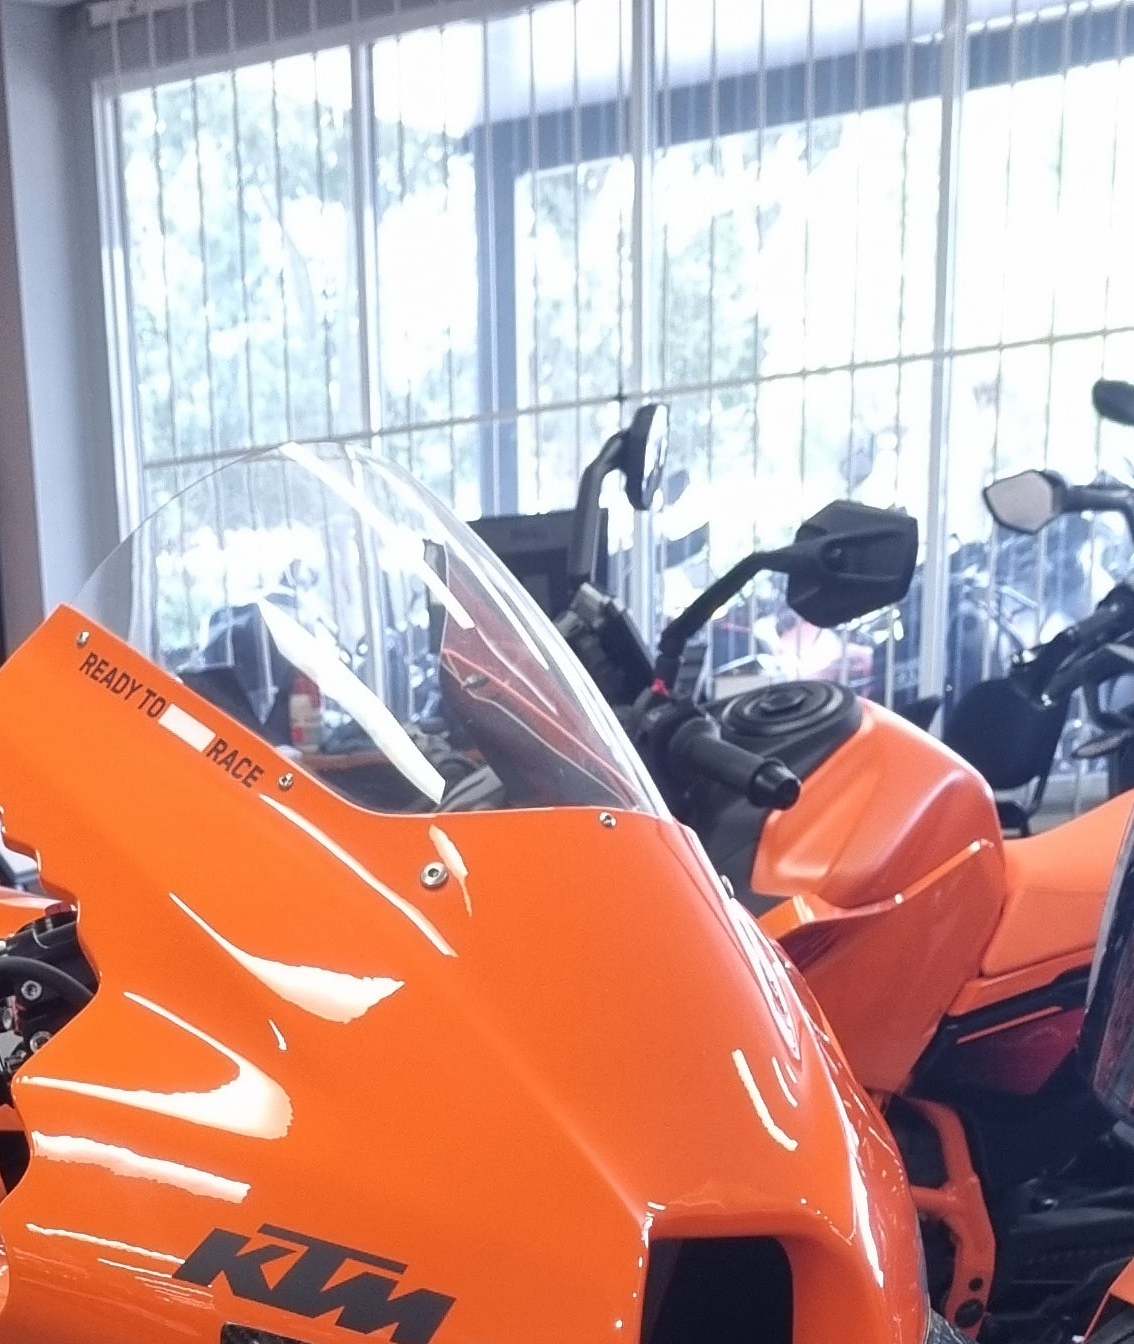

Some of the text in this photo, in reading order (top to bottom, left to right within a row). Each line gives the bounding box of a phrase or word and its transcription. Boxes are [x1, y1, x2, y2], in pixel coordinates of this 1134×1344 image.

[79, 652, 264, 788] READY TO RACE
